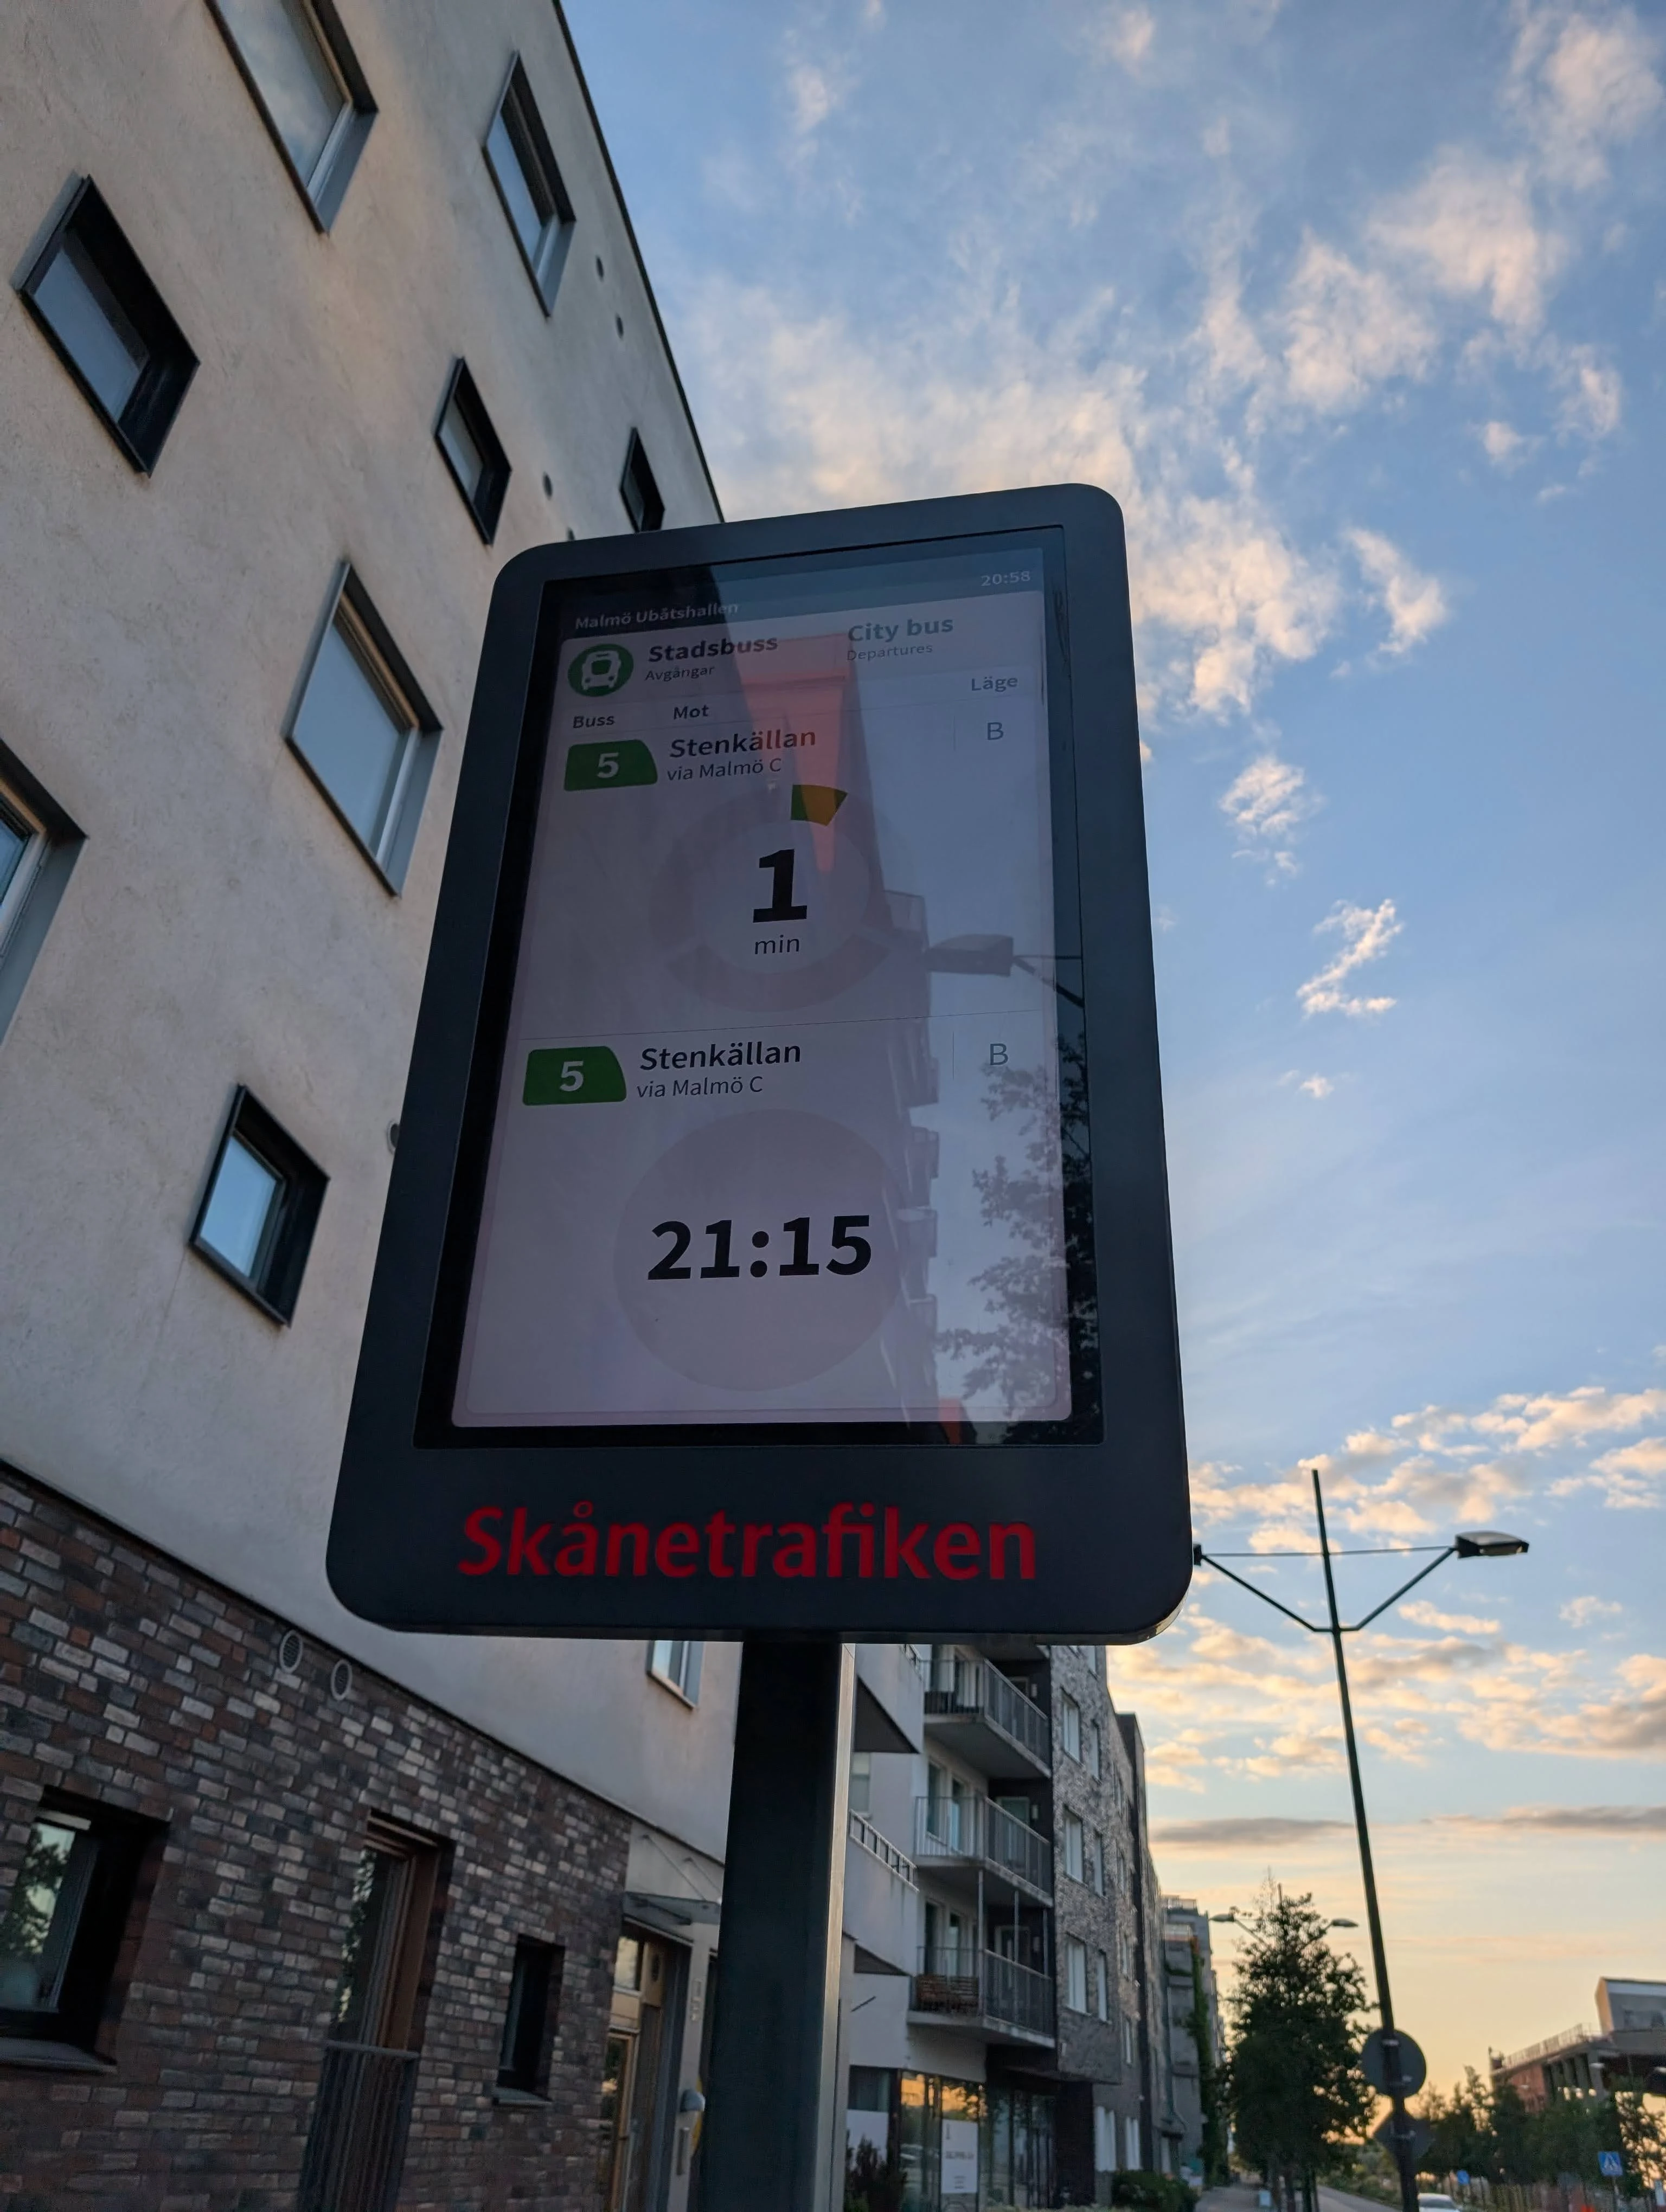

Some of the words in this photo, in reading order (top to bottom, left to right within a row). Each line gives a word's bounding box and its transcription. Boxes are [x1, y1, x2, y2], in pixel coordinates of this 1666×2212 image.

[981, 571, 1030, 587] 20:58
[575, 612, 631, 629] Malmö
[636, 603, 738, 623] Ubåtshallen
[848, 623, 899, 642] City
[907, 619, 953, 636] bus
[648, 635, 778, 662] Stadsbuss
[847, 645, 933, 661] Departures
[645, 665, 715, 681] Avgångar
[971, 677, 1018, 692] Läge
[573, 715, 615, 729] Buss
[673, 705, 709, 720] Mot
[987, 722, 1004, 741] B
[670, 729, 816, 758] Stenkällan
[597, 753, 619, 778] 5
[667, 766, 693, 781] via
[700, 760, 763, 777] Malmö
[770, 758, 781, 772] C
[753, 849, 808, 923] 1
[754, 935, 799, 954] min
[639, 1041, 802, 1071] Stenkällan
[990, 1042, 1009, 1066] B
[559, 1060, 584, 1092] 5
[636, 1079, 665, 1098] via
[672, 1075, 743, 1096] Malmö
[749, 1075, 763, 1092] C
[648, 1215, 872, 1280] 21:15
[457, 1500, 1036, 1580] Skånetrafiken
